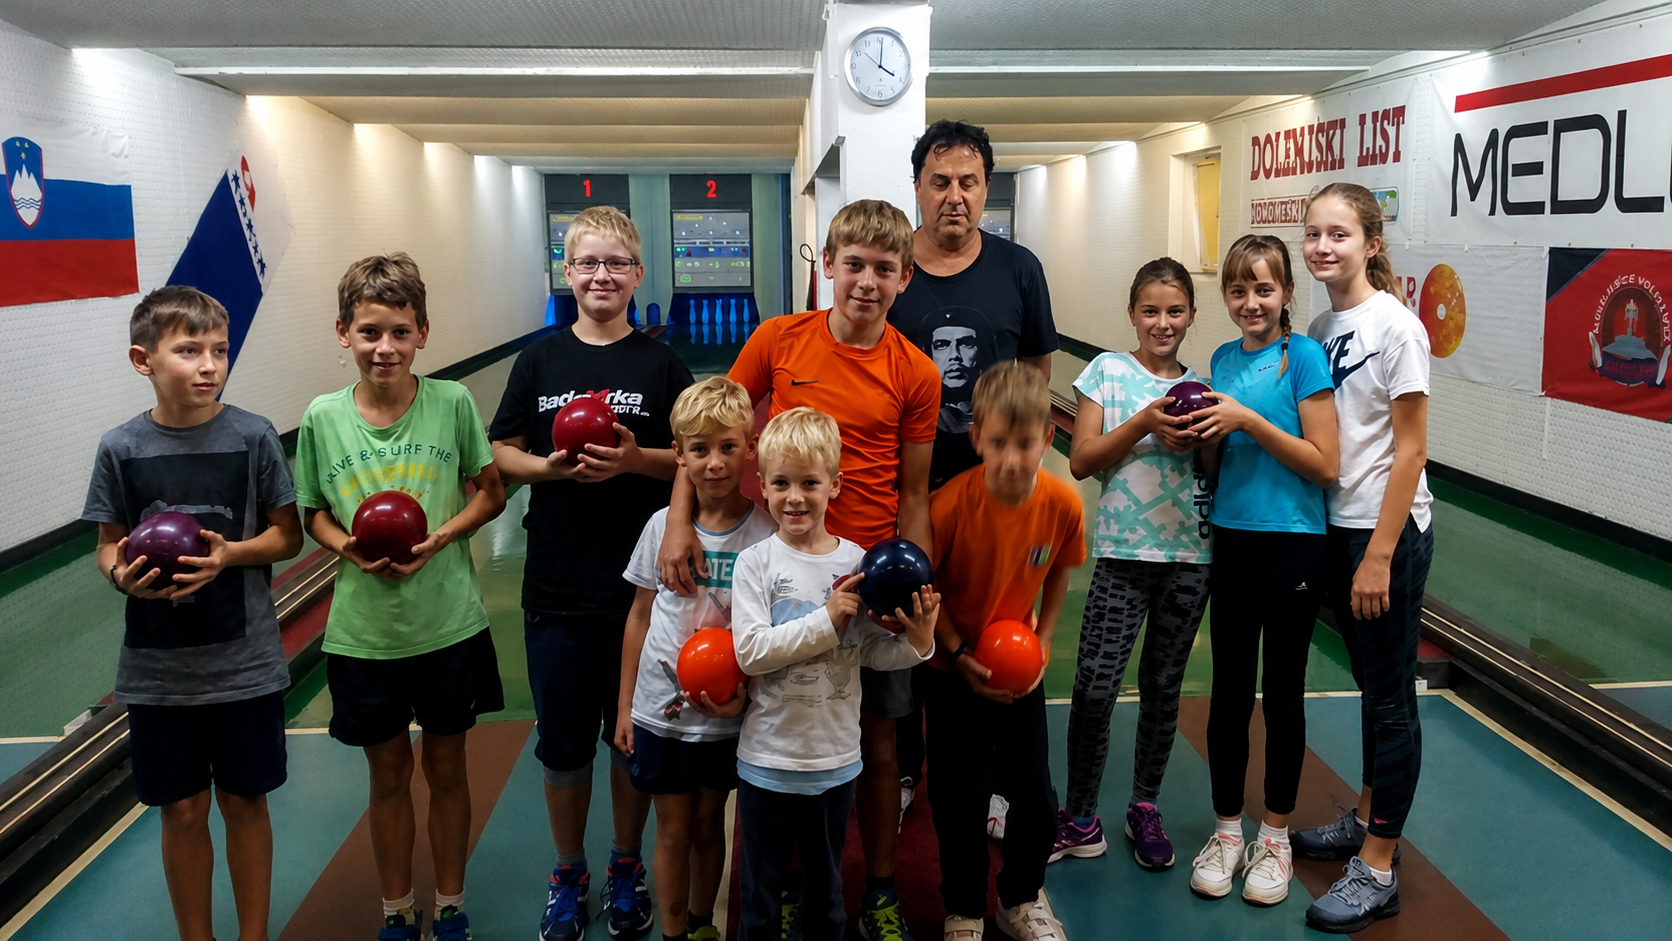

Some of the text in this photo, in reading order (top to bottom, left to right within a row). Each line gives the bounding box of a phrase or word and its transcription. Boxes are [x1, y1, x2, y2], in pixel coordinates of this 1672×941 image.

[1356, 105, 1406, 167] LIST
[1450, 109, 1672, 217] MEDL
[583, 179, 591, 198] 1
[706, 180, 717, 198] 2
[378, 443, 422, 458] SURF
[428, 445, 452, 463] THE
[702, 557, 734, 581] ATE
